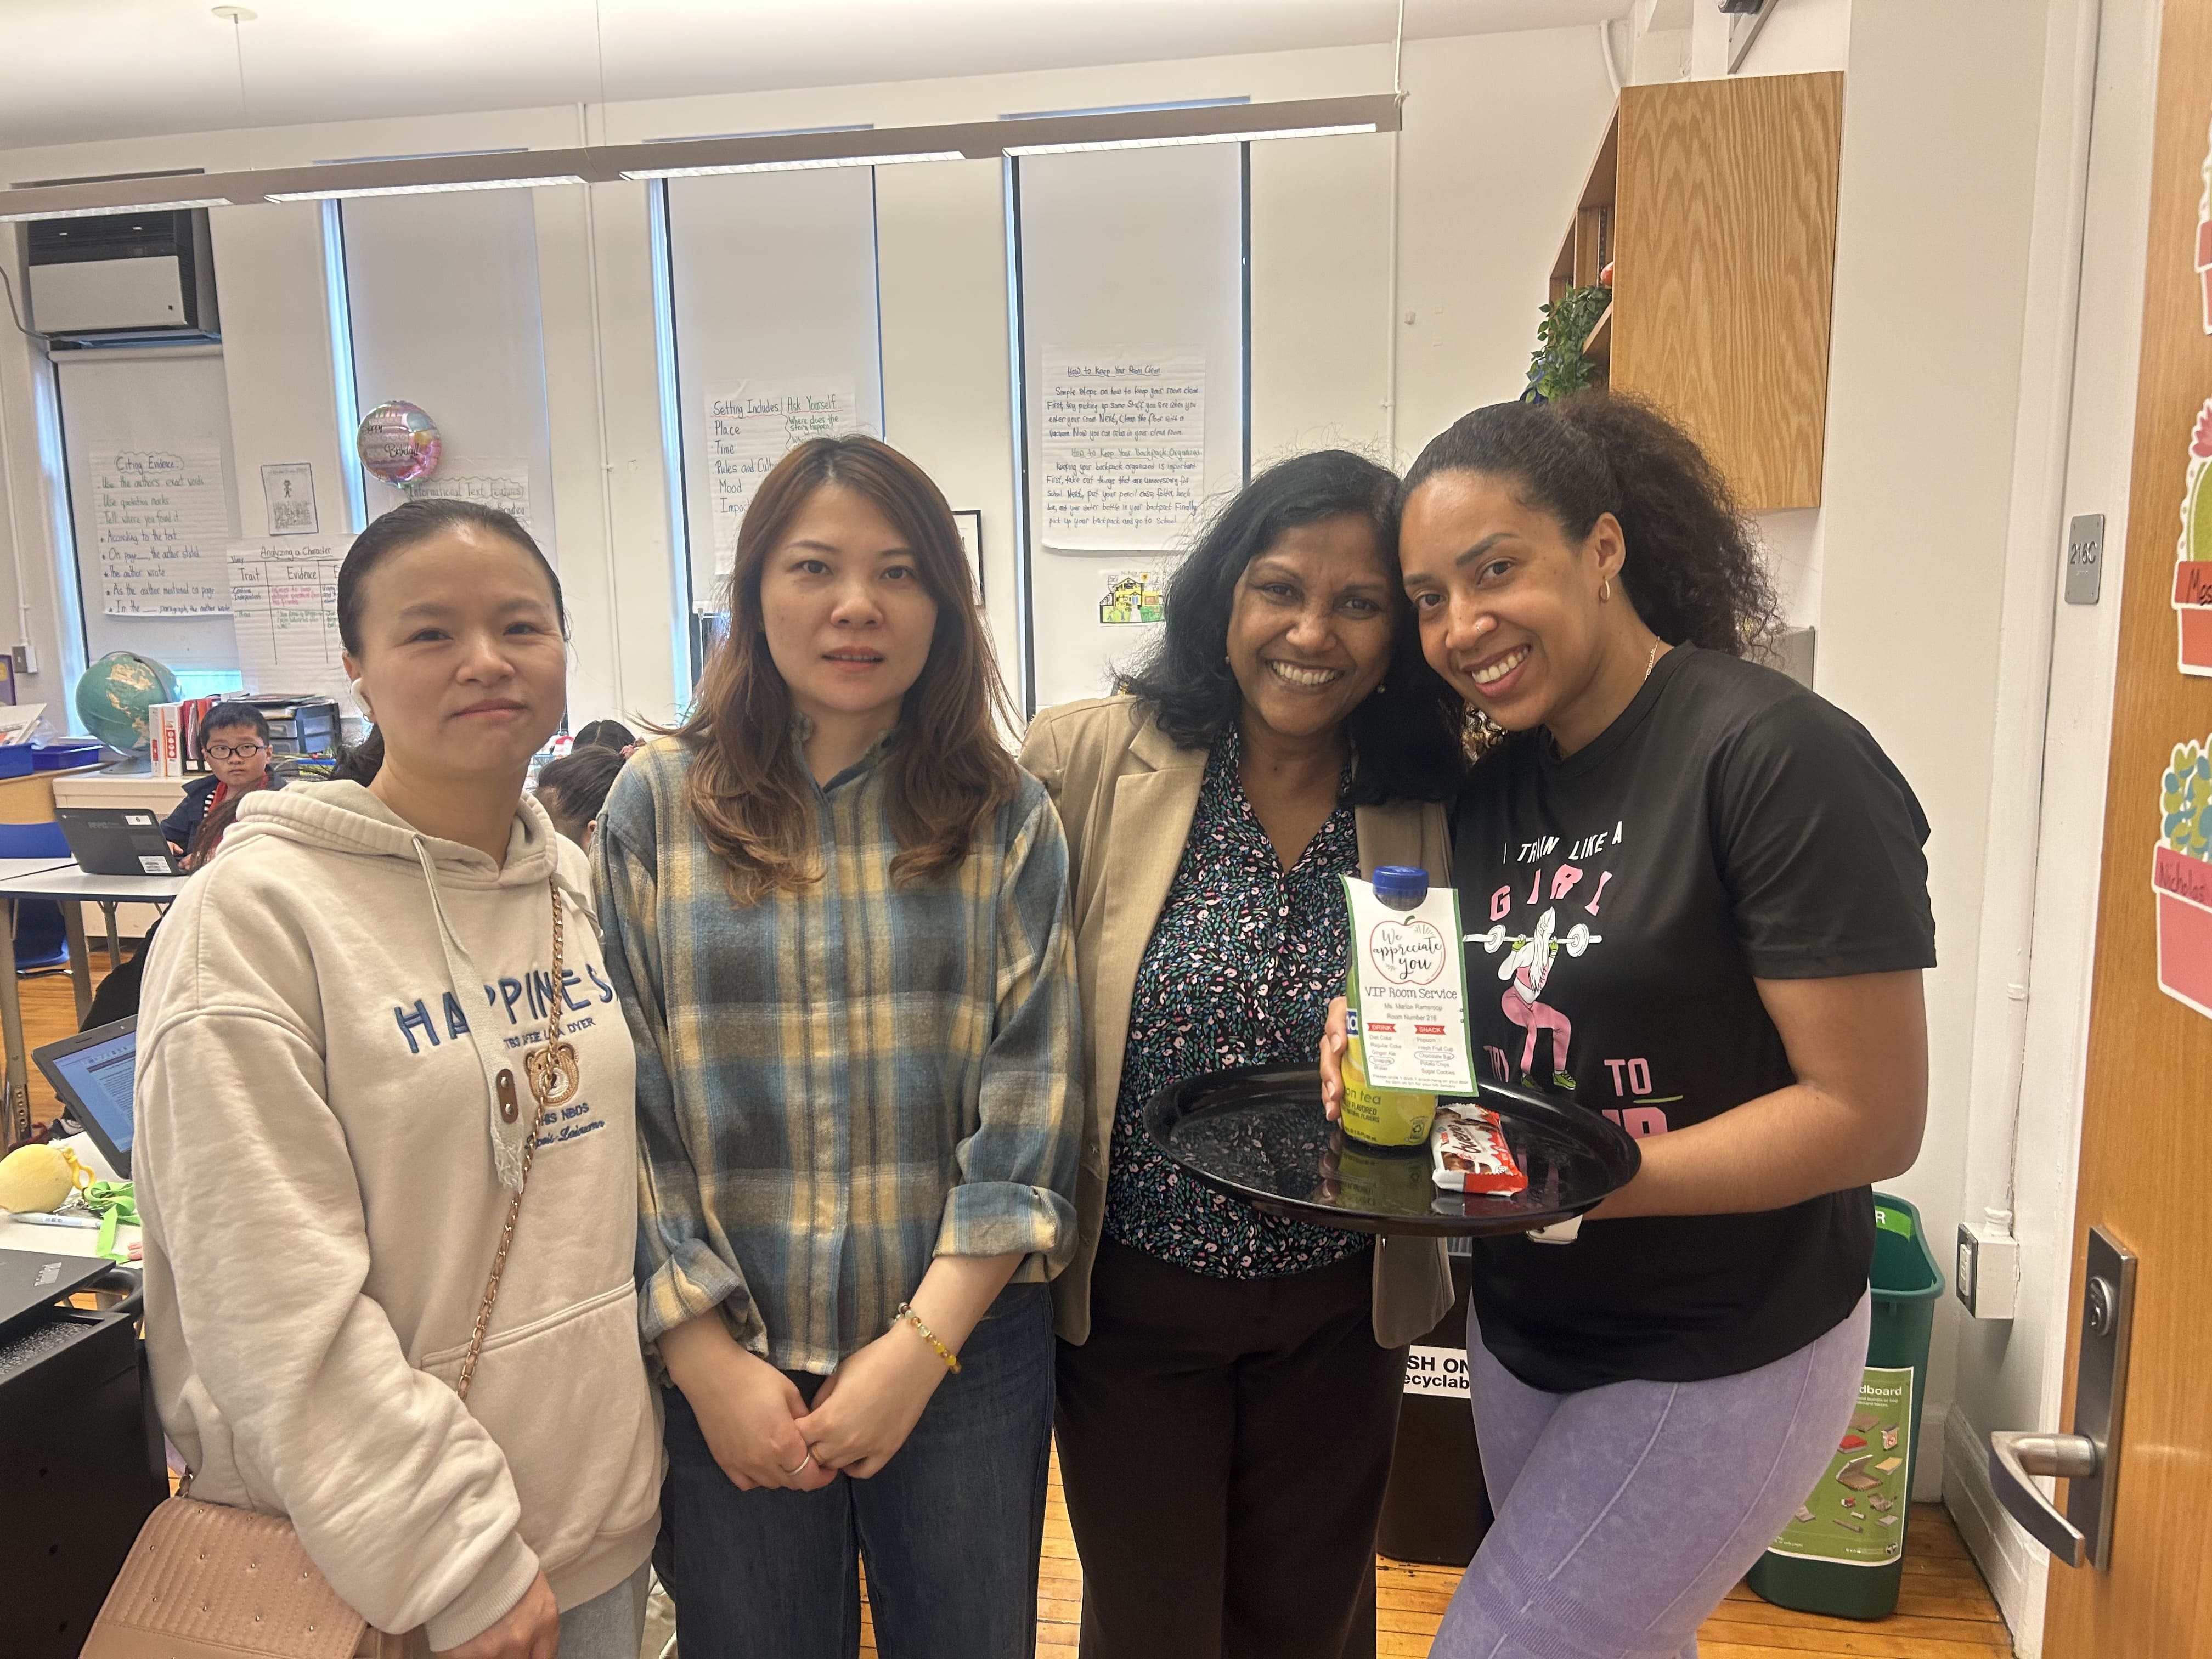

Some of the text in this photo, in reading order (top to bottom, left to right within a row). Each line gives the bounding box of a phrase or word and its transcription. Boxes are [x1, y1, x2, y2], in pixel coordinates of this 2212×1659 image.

[1068, 366, 1081, 375] How
[1095, 366, 1110, 376] Keep
[1129, 365, 1142, 374] Room
[1145, 365, 1160, 374] Clean
[1056, 386, 1075, 398] Simple
[1111, 386, 1121, 395] how
[1124, 386, 1131, 395] to
[1135, 386, 1148, 397] keep
[1150, 387, 1164, 398] your
[713, 399, 779, 419] Setting Includes
[788, 394, 836, 411] Ask Yourself
[1066, 400, 1076, 411] try
[1079, 402, 1098, 413] picking
[1146, 403, 1156, 413] you
[1185, 402, 1196, 411] you
[788, 414, 839, 427] Where does the
[1067, 416, 1080, 427] your
[1099, 413, 1118, 425] Next,
[1138, 414, 1146, 423] the
[714, 420, 741, 436] Place
[790, 424, 809, 435] story
[1073, 427, 1087, 437] Now
[1090, 430, 1099, 441] you
[1135, 430, 1147, 441] your
[1150, 428, 1165, 436] clean
[715, 439, 735, 454] Time
[1087, 448, 1096, 456] to
[116, 456, 143, 475] Citing
[715, 457, 777, 474] Rules and Cult
[102, 475, 131, 488] Use the
[467, 482, 483, 496] Text
[719, 478, 742, 493] Mood
[1065, 475, 1080, 484] take
[1097, 475, 1115, 490] things
[103, 493, 116, 507] Use
[1144, 516, 1152, 524] to
[108, 529, 139, 545] According
[140, 529, 149, 541] to
[153, 528, 162, 541] the
[109, 547, 121, 561] On
[2070, 541, 2097, 565] 216C
[147, 564, 166, 577] wrote
[238, 567, 260, 582] Trait
[287, 566, 317, 580] Evidence
[114, 583, 123, 595] As
[126, 582, 136, 596] the
[115, 599, 140, 613] In the
[1568, 832, 1608, 860] LIKE
[1612, 821, 1622, 844] A
[1383, 928, 1402, 944] We
[1373, 936, 1442, 964] appreciate
[1399, 958, 1431, 979] you
[1365, 987, 1457, 999] VIP Room Service
[1604, 1058, 1652, 1096] TO
[1360, 1090, 1381, 1105] tea
[1407, 1355, 1469, 1373] SH ON
[1404, 1375, 1470, 1390] ecyclab
[1859, 1384, 1902, 1396] dboard
